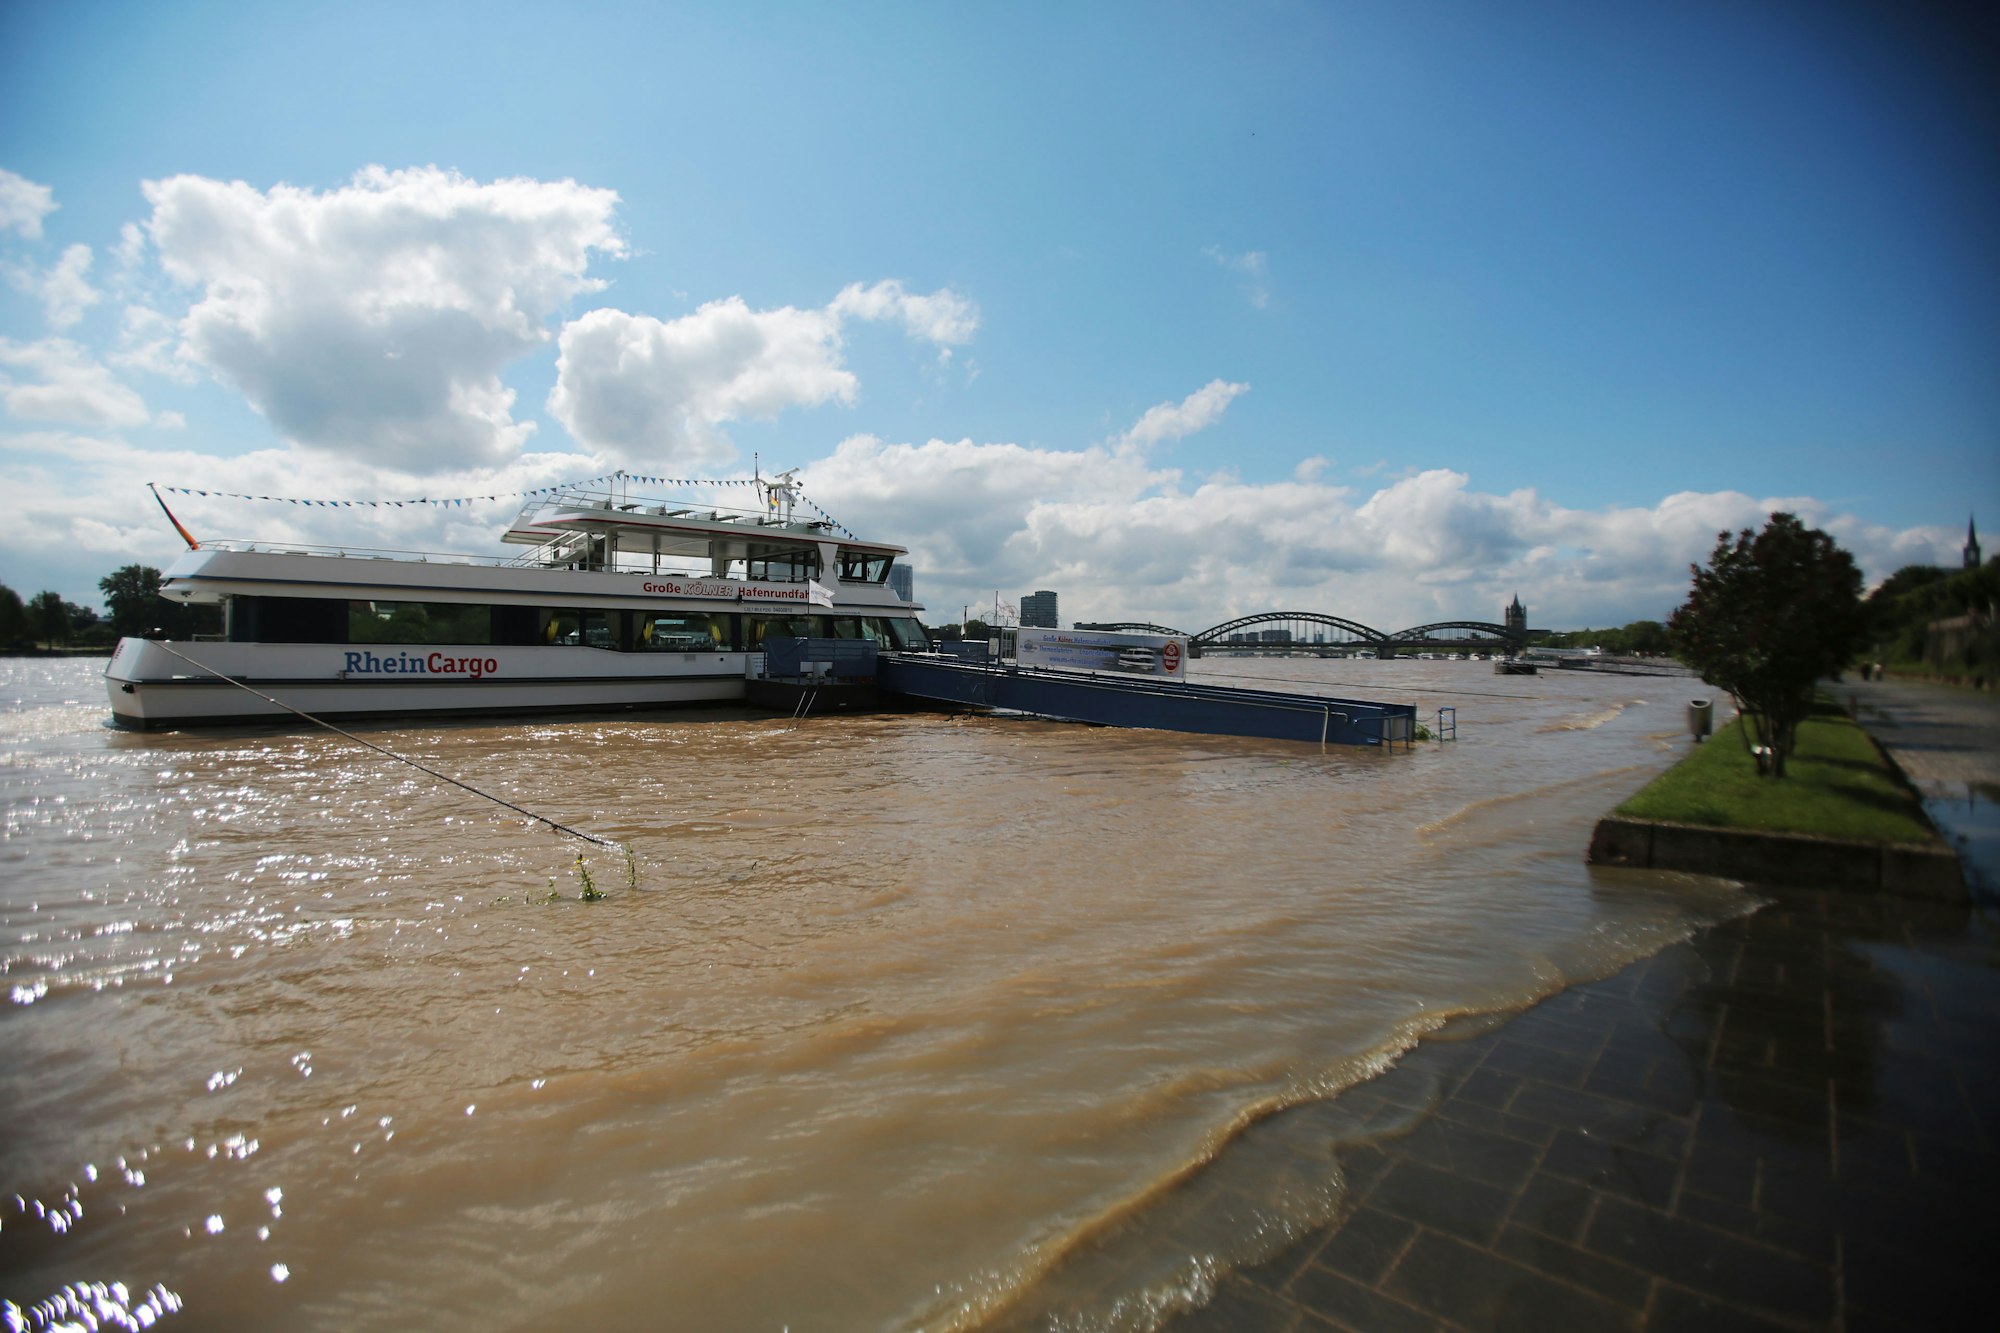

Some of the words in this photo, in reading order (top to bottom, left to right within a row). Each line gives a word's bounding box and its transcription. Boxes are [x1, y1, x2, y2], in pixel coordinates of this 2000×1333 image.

[643, 582, 681, 594] Große
[684, 581, 733, 596] KÖLNER
[738, 586, 810, 599] Hafenrundfah
[344, 651, 498, 679] RheinCargo
